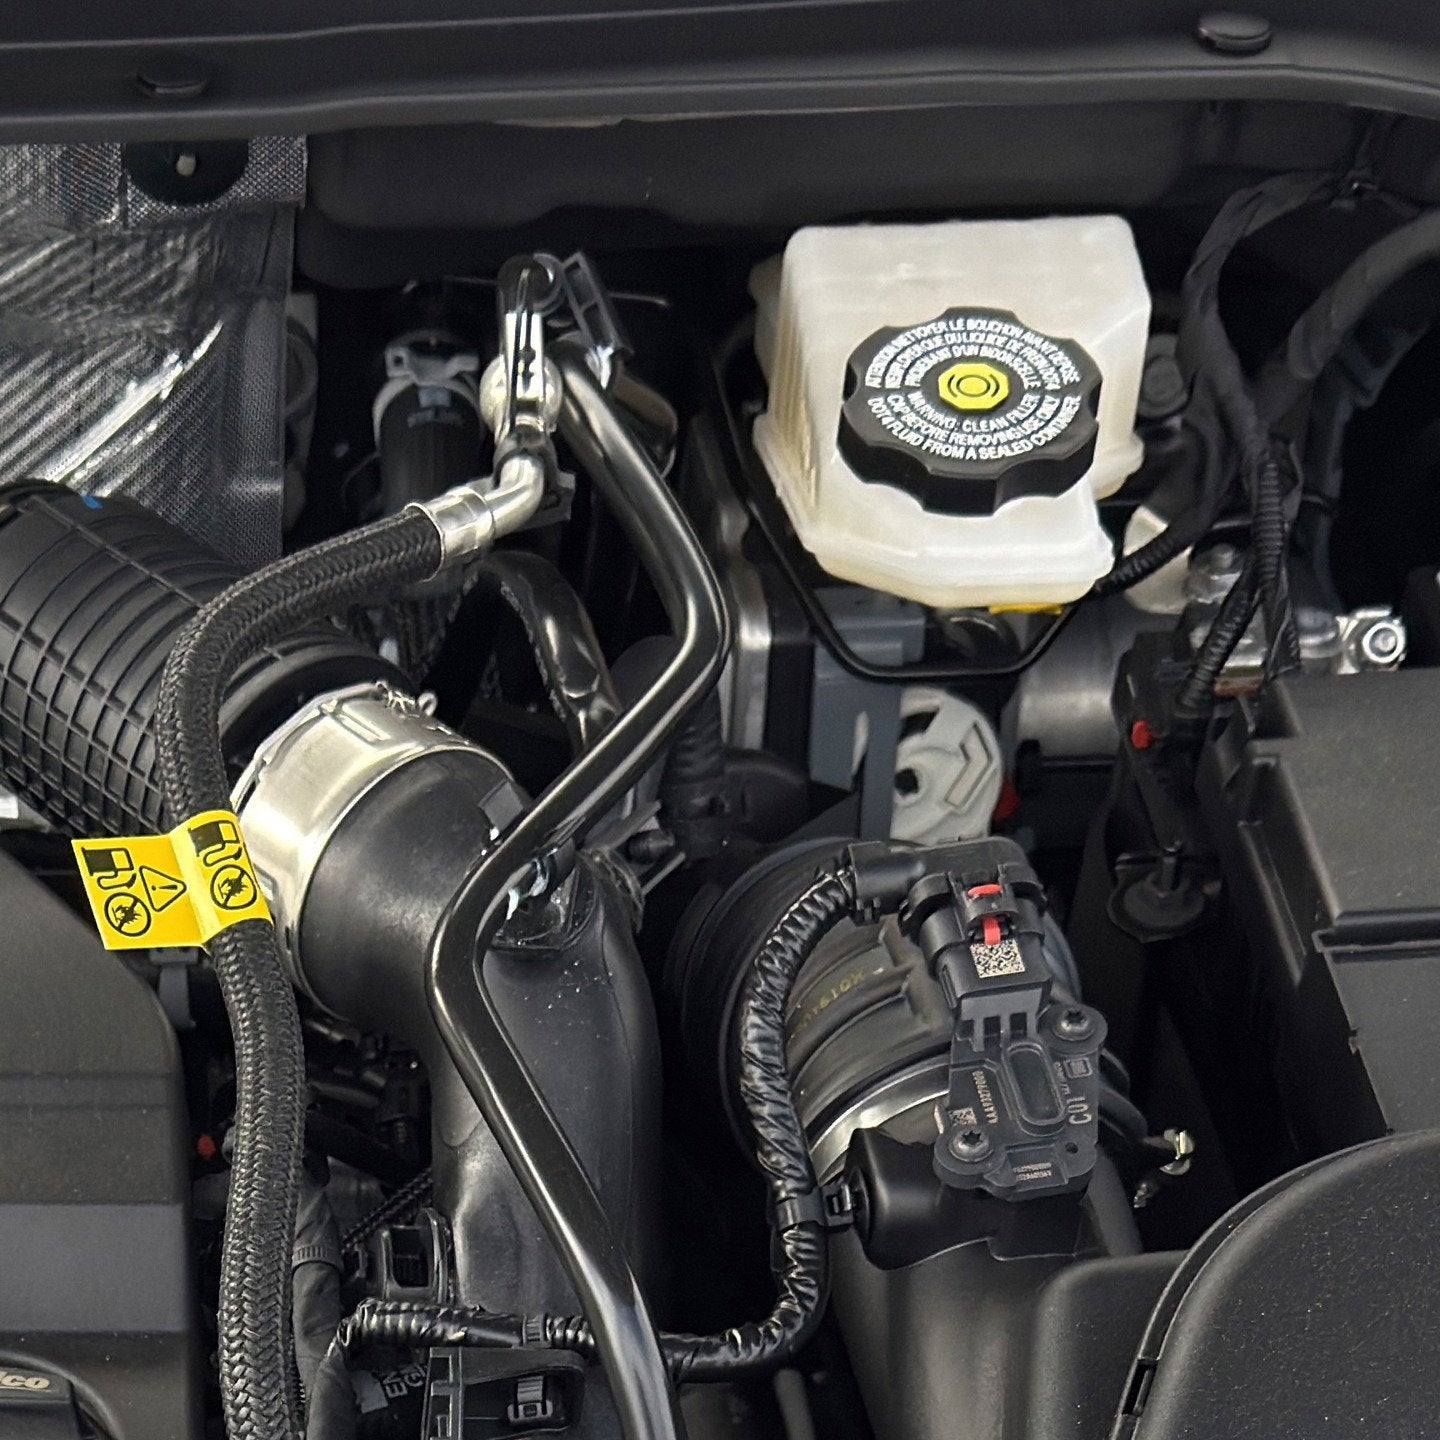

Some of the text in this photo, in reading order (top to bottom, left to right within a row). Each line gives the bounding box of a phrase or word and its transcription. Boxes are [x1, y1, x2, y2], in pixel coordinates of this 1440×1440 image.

[886, 395, 1060, 446] CAP BEFORE REMOVING USE ONLY
[890, 423, 925, 449] FLUID
[924, 440, 964, 458] FROM
[980, 439, 1034, 459] SEALED
[1030, 395, 1081, 446] CONTAINER
[962, 416, 1009, 432] CLEAN
[1007, 394, 1036, 423] FILLER
